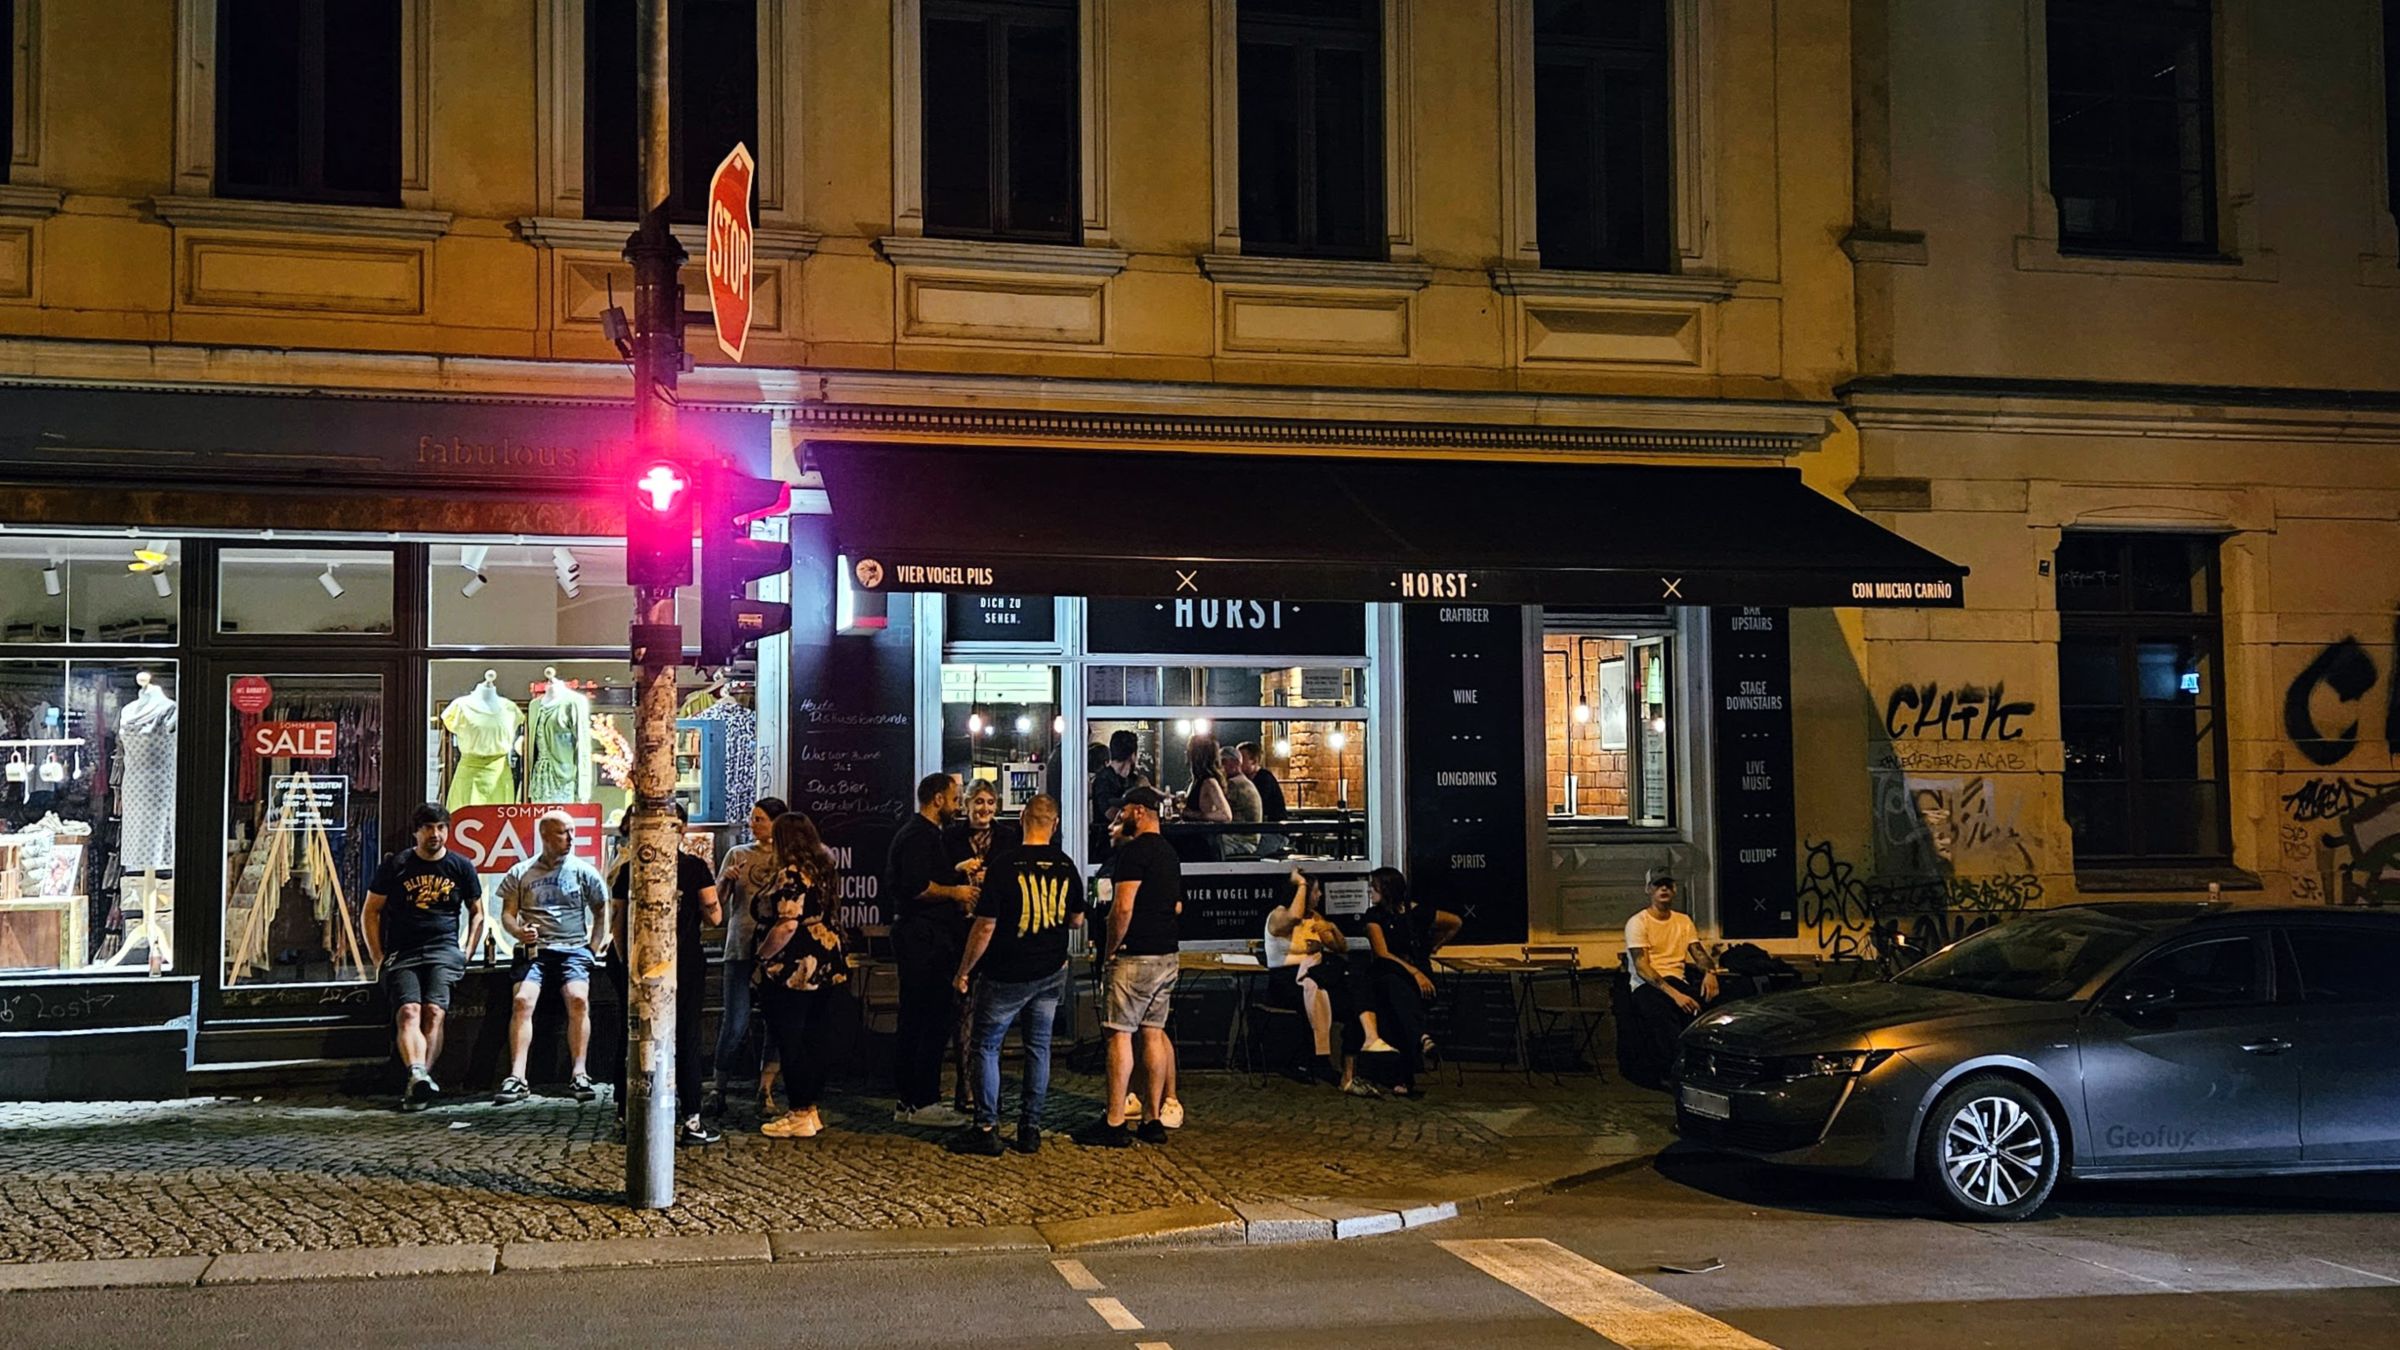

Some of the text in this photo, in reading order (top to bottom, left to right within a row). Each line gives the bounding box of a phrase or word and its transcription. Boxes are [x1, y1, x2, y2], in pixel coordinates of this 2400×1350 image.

[712, 200, 749, 300] STOP
[417, 436, 578, 467] fabulous
[897, 565, 993, 585] VIER VOGEL PILS
[1402, 572, 1467, 598] HORST
[1852, 580, 1952, 598] CON MUCHO CARIÑO
[980, 597, 1021, 608] DICH ZU
[984, 613, 1021, 625] SEHEN.
[1440, 608, 1489, 622] CRAFTBEER
[1731, 617, 1773, 631] UPSTAIRS
[1740, 681, 1767, 695] STAGE
[1453, 689, 1478, 704] WINE
[1726, 696, 1783, 710] DOWNSTAIRS
[255, 728, 334, 755] SALE
[1745, 761, 1766, 775] LIVE
[1975, 751, 2026, 770] ACAB
[1437, 771, 1497, 786] LONGDRINKS
[1742, 775, 1772, 790] MUSIC
[806, 779, 837, 795] Das
[1451, 854, 1486, 869] SPIRITS
[1187, 888, 1274, 900] VIER VOGEL BAR
